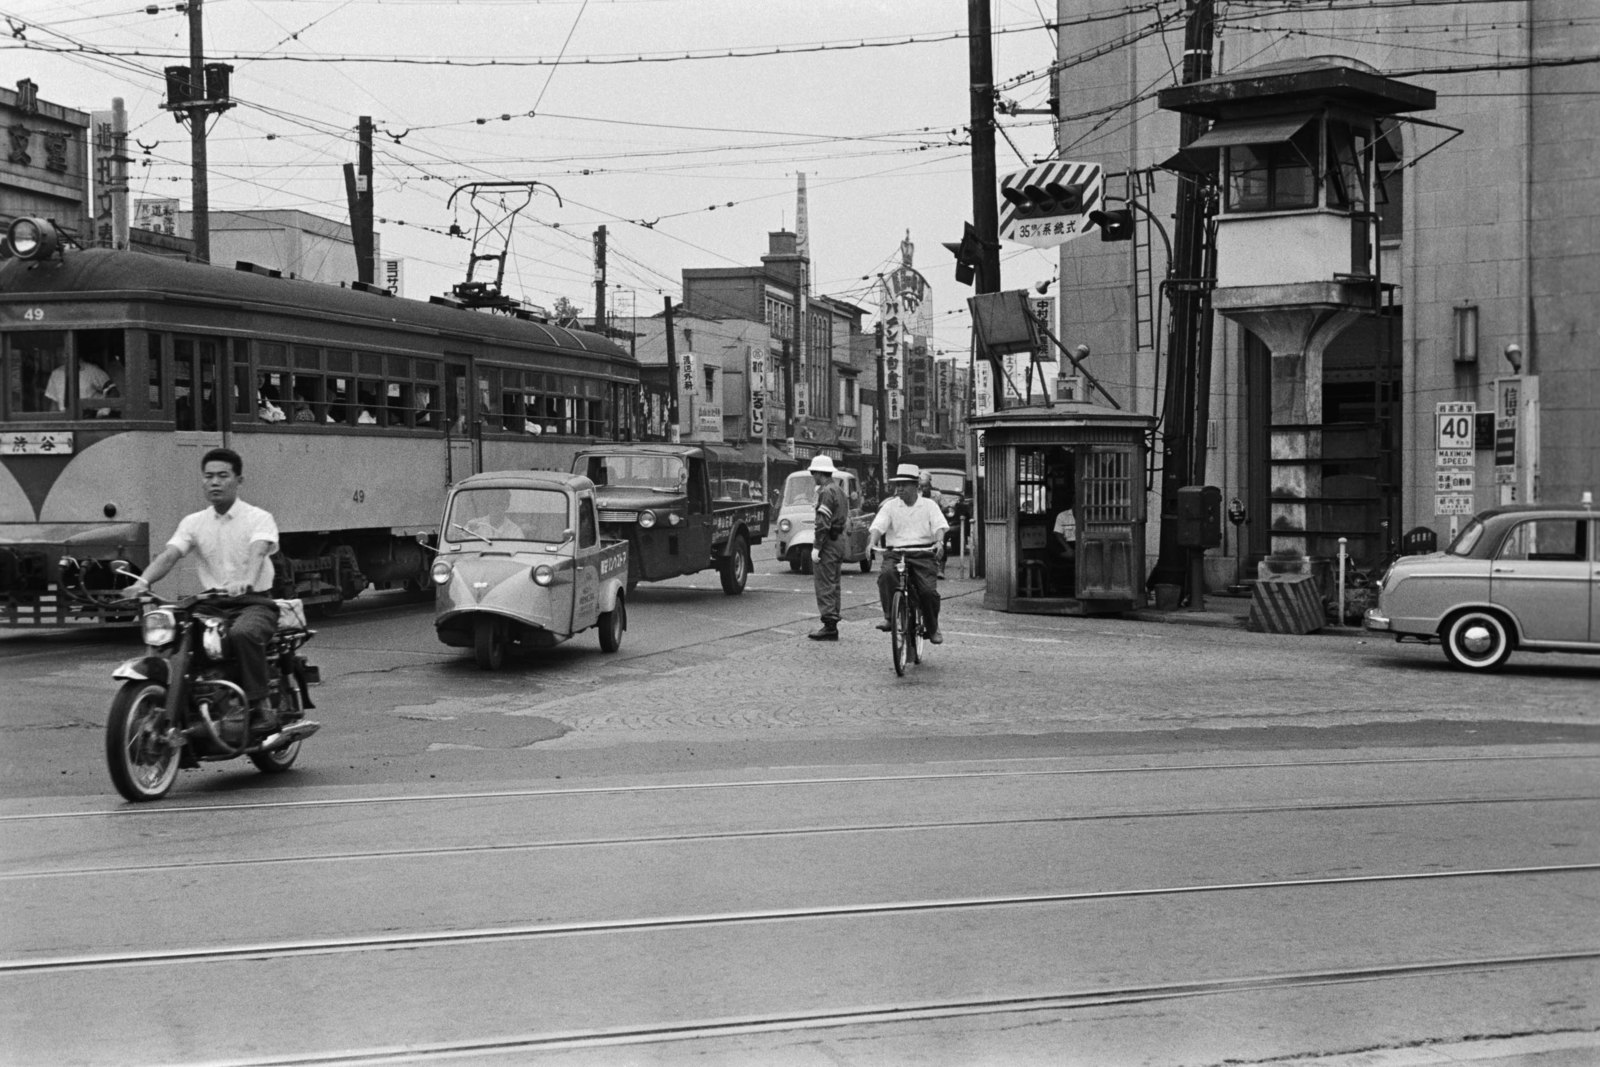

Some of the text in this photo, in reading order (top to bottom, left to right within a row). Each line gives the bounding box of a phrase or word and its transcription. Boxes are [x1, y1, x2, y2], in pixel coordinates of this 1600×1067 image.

[24, 308, 44, 321] 49
[1442, 417, 1469, 439] 40
[1442, 457, 1468, 465] SPEED
[353, 489, 365, 503] 49
